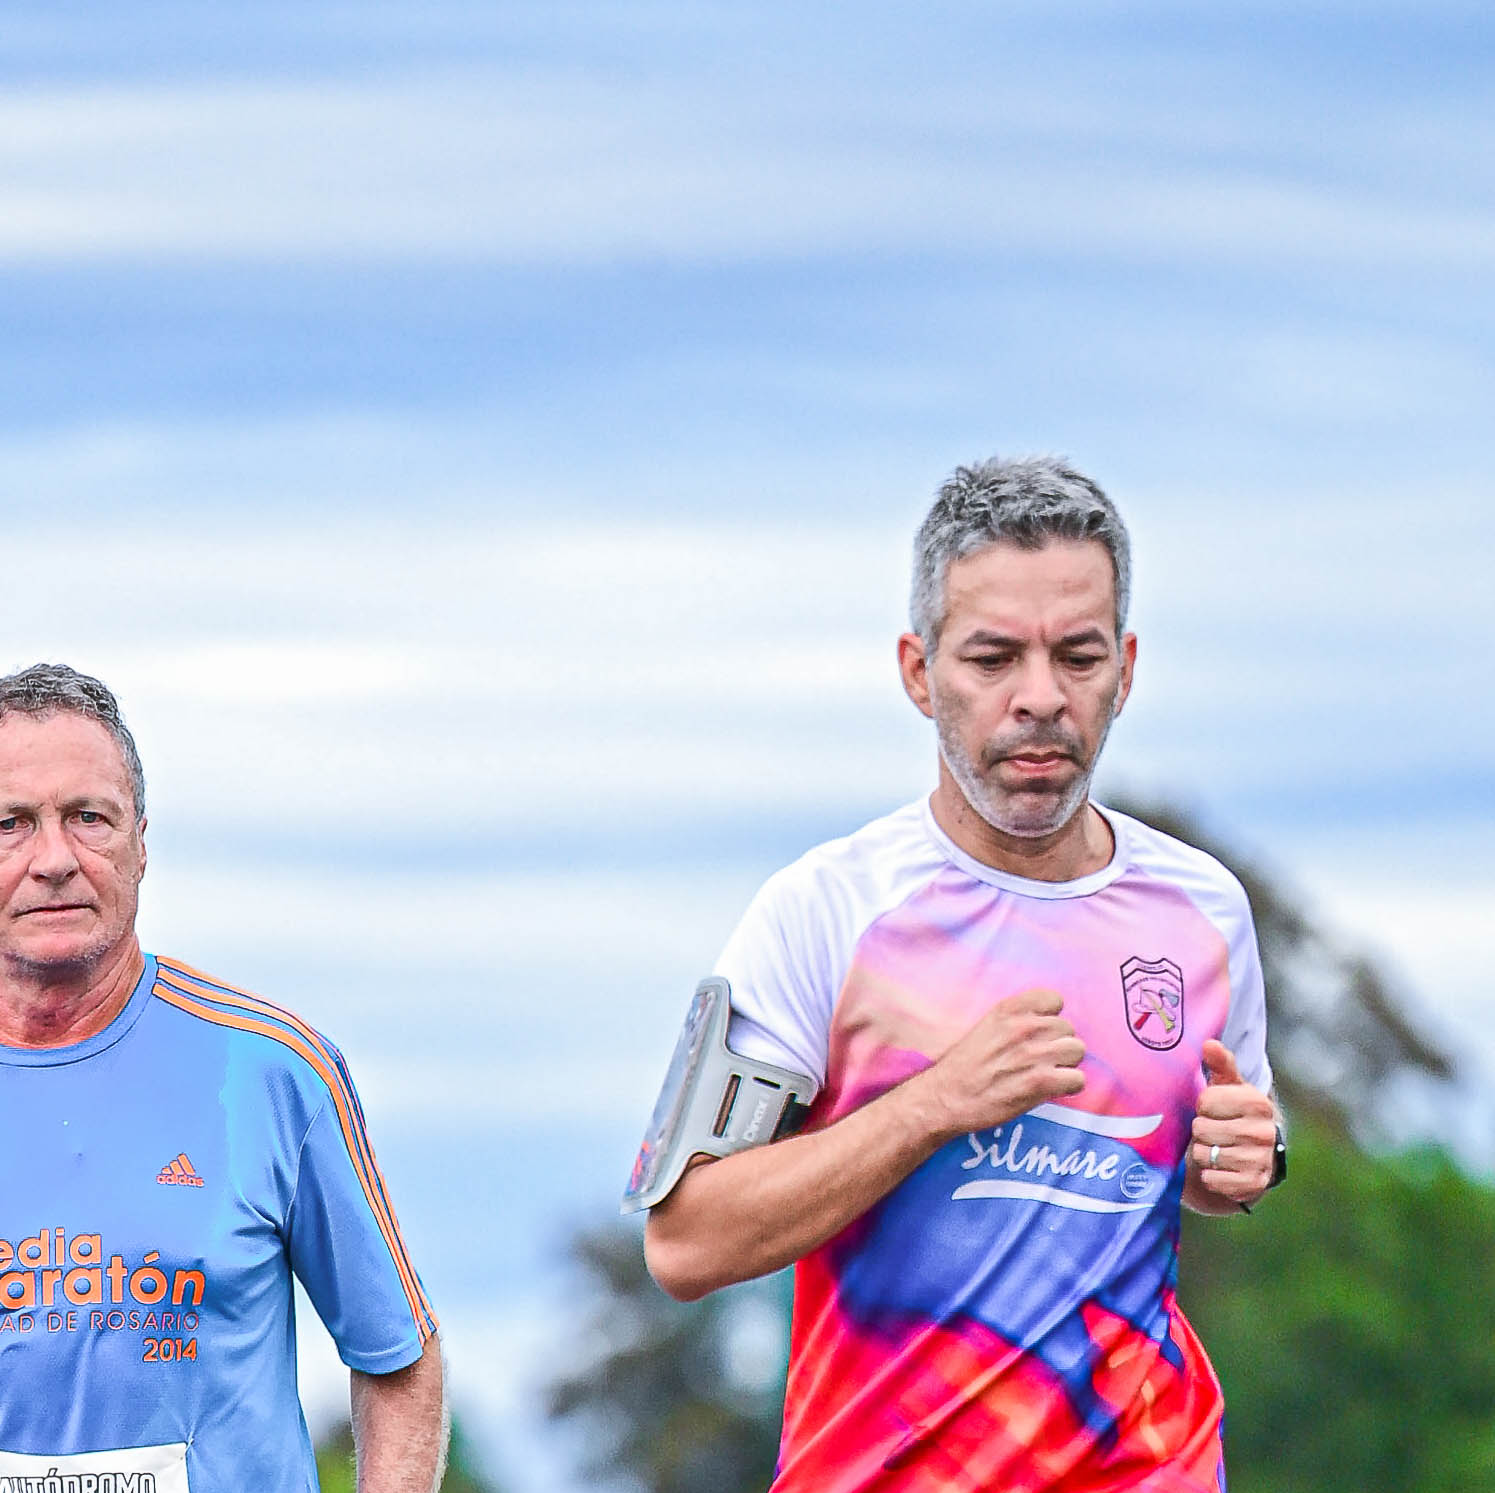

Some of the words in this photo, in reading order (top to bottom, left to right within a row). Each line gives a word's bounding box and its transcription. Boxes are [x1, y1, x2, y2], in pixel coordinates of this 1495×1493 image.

[156, 1174, 205, 1187] adidas
[47, 1312, 77, 1332] DE
[90, 1310, 199, 1332] ROSARIO
[143, 1338, 198, 1362] 2014
